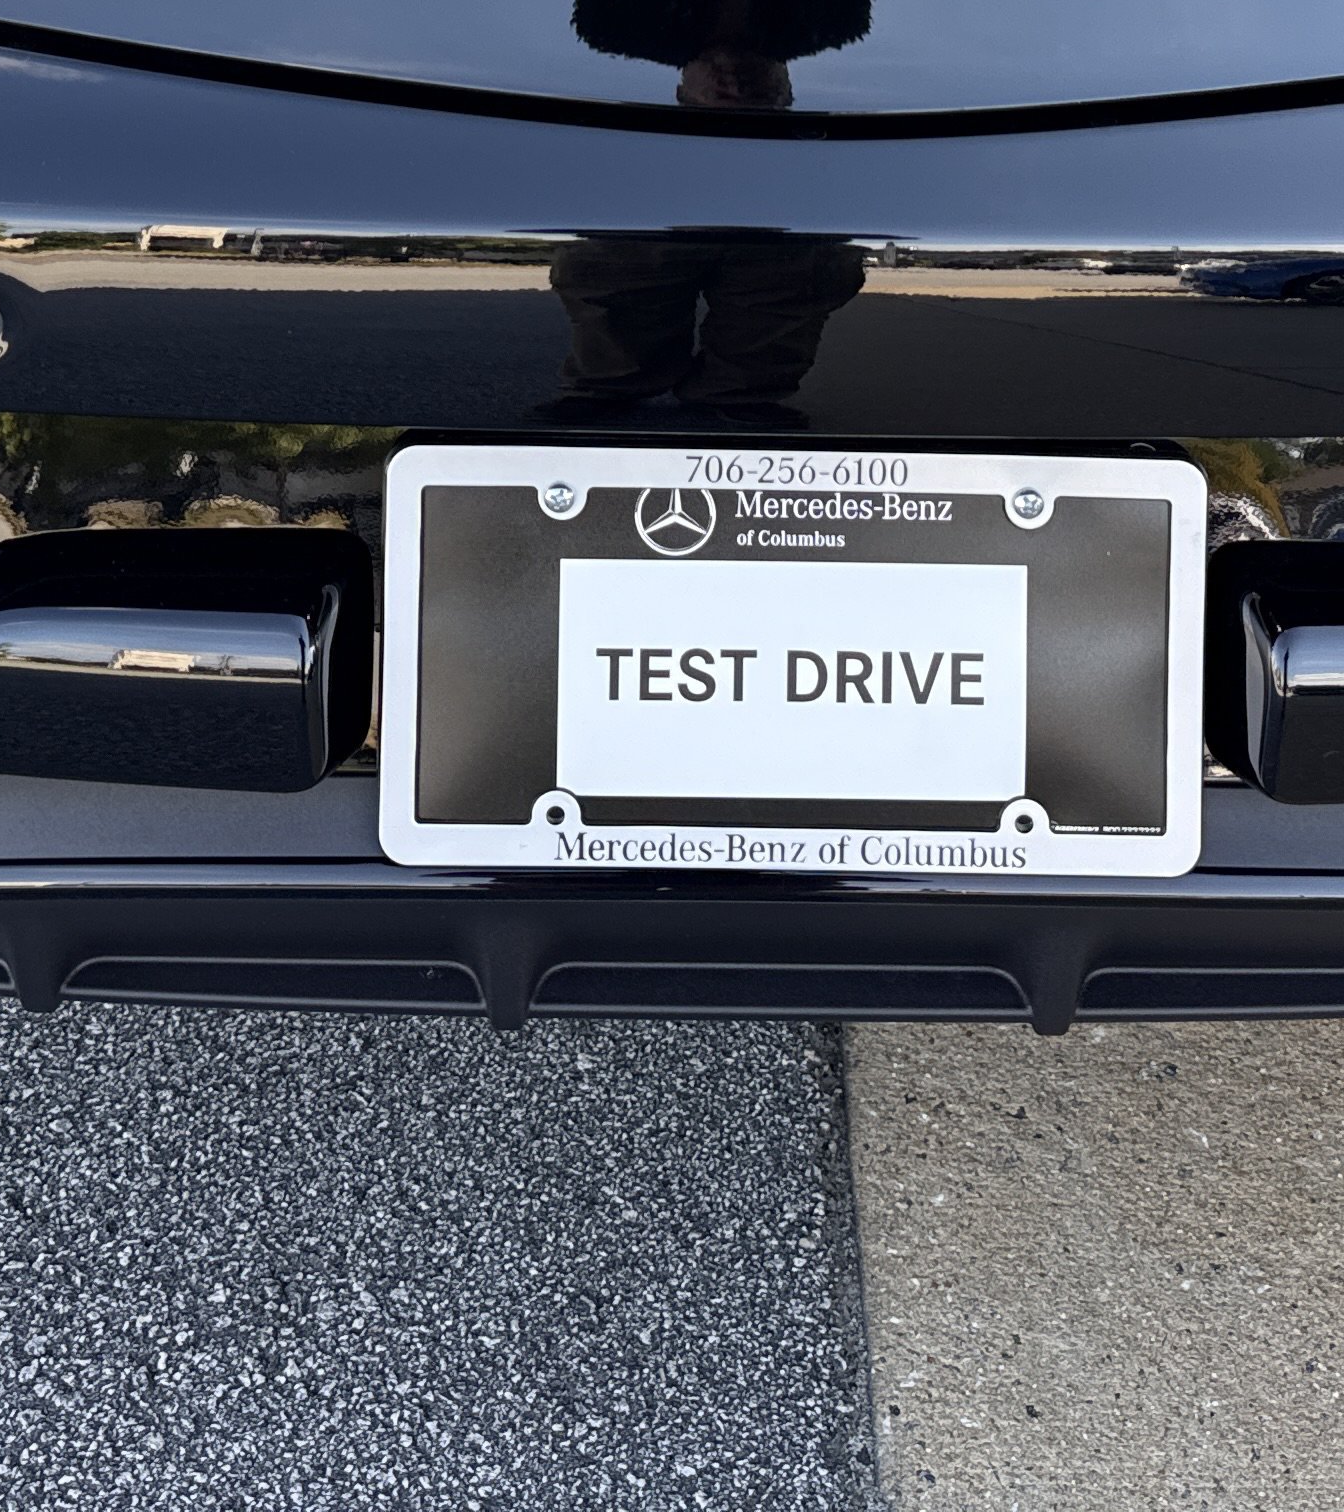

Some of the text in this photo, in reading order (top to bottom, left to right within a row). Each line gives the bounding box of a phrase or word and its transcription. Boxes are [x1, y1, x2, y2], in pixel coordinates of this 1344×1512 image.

[685, 455, 909, 486] 706-256-6100
[735, 491, 954, 521] Mercedes-Benz
[736, 530, 846, 547] of Columbus
[596, 648, 984, 706] TEST DRIVE
[553, 831, 1027, 869] Mercedes-Benz of Columbus
